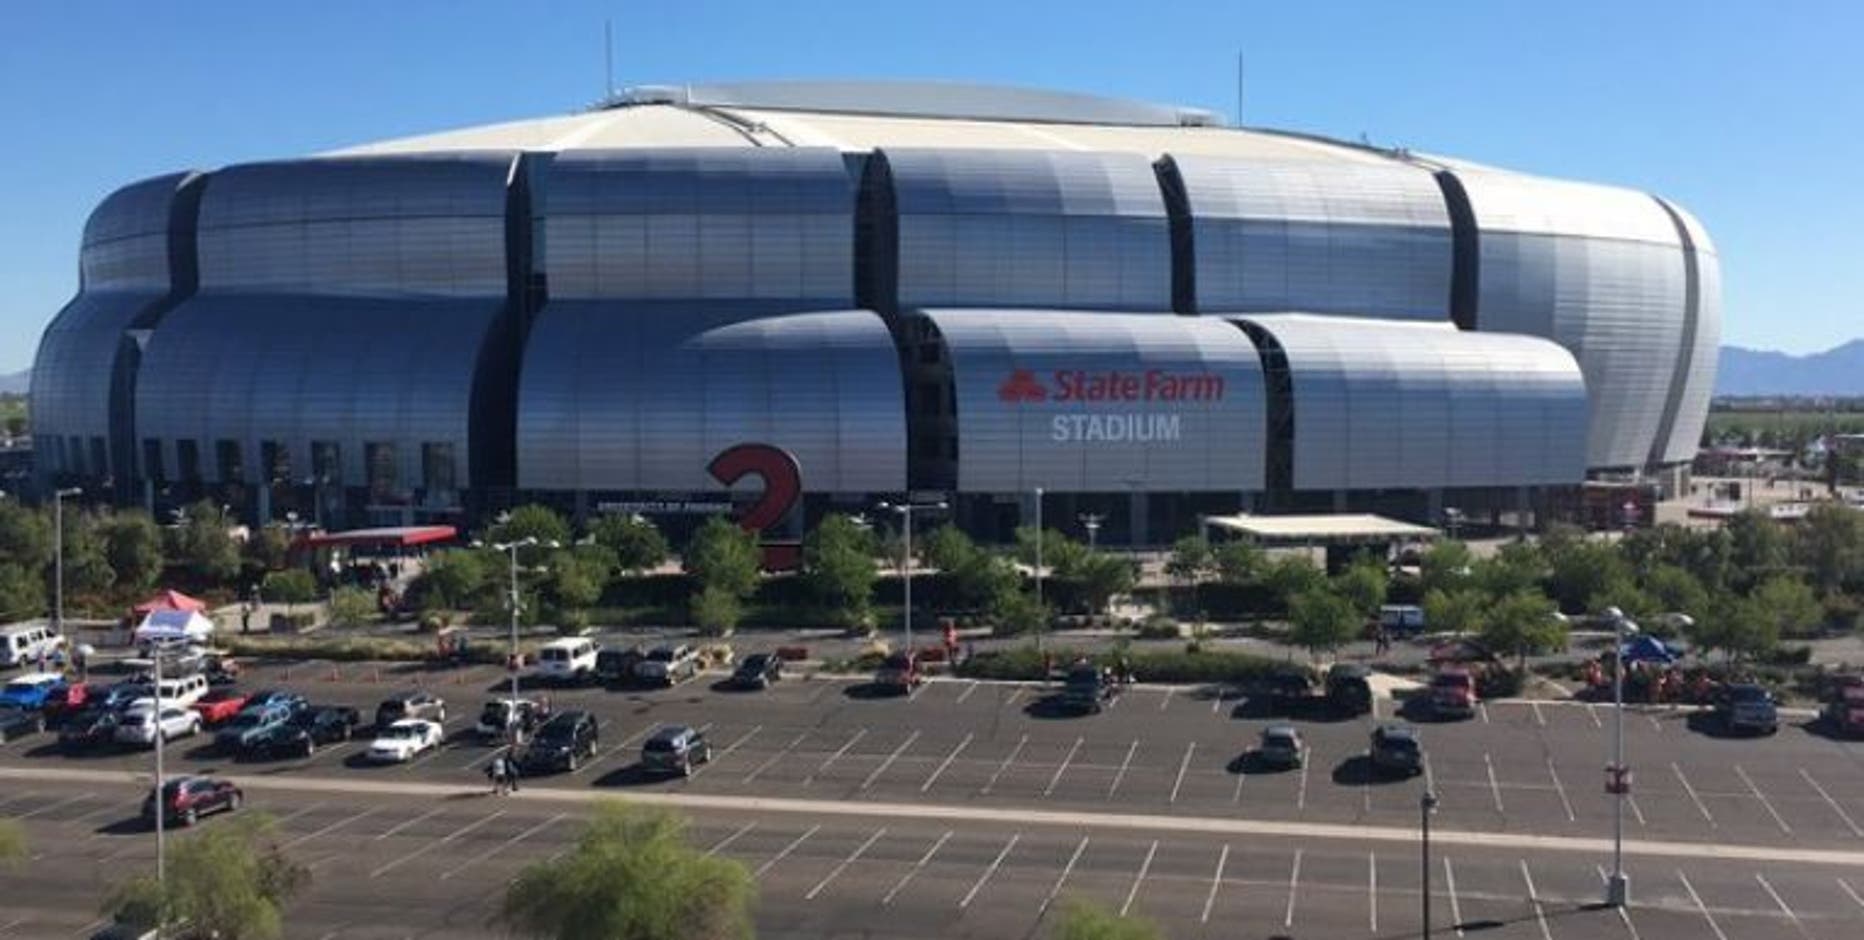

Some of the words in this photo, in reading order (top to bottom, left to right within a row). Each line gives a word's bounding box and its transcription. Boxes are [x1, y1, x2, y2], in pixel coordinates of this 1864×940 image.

[1053, 369, 1140, 400] State
[1145, 369, 1224, 400] Farm
[1052, 413, 1180, 441] STADIUM
